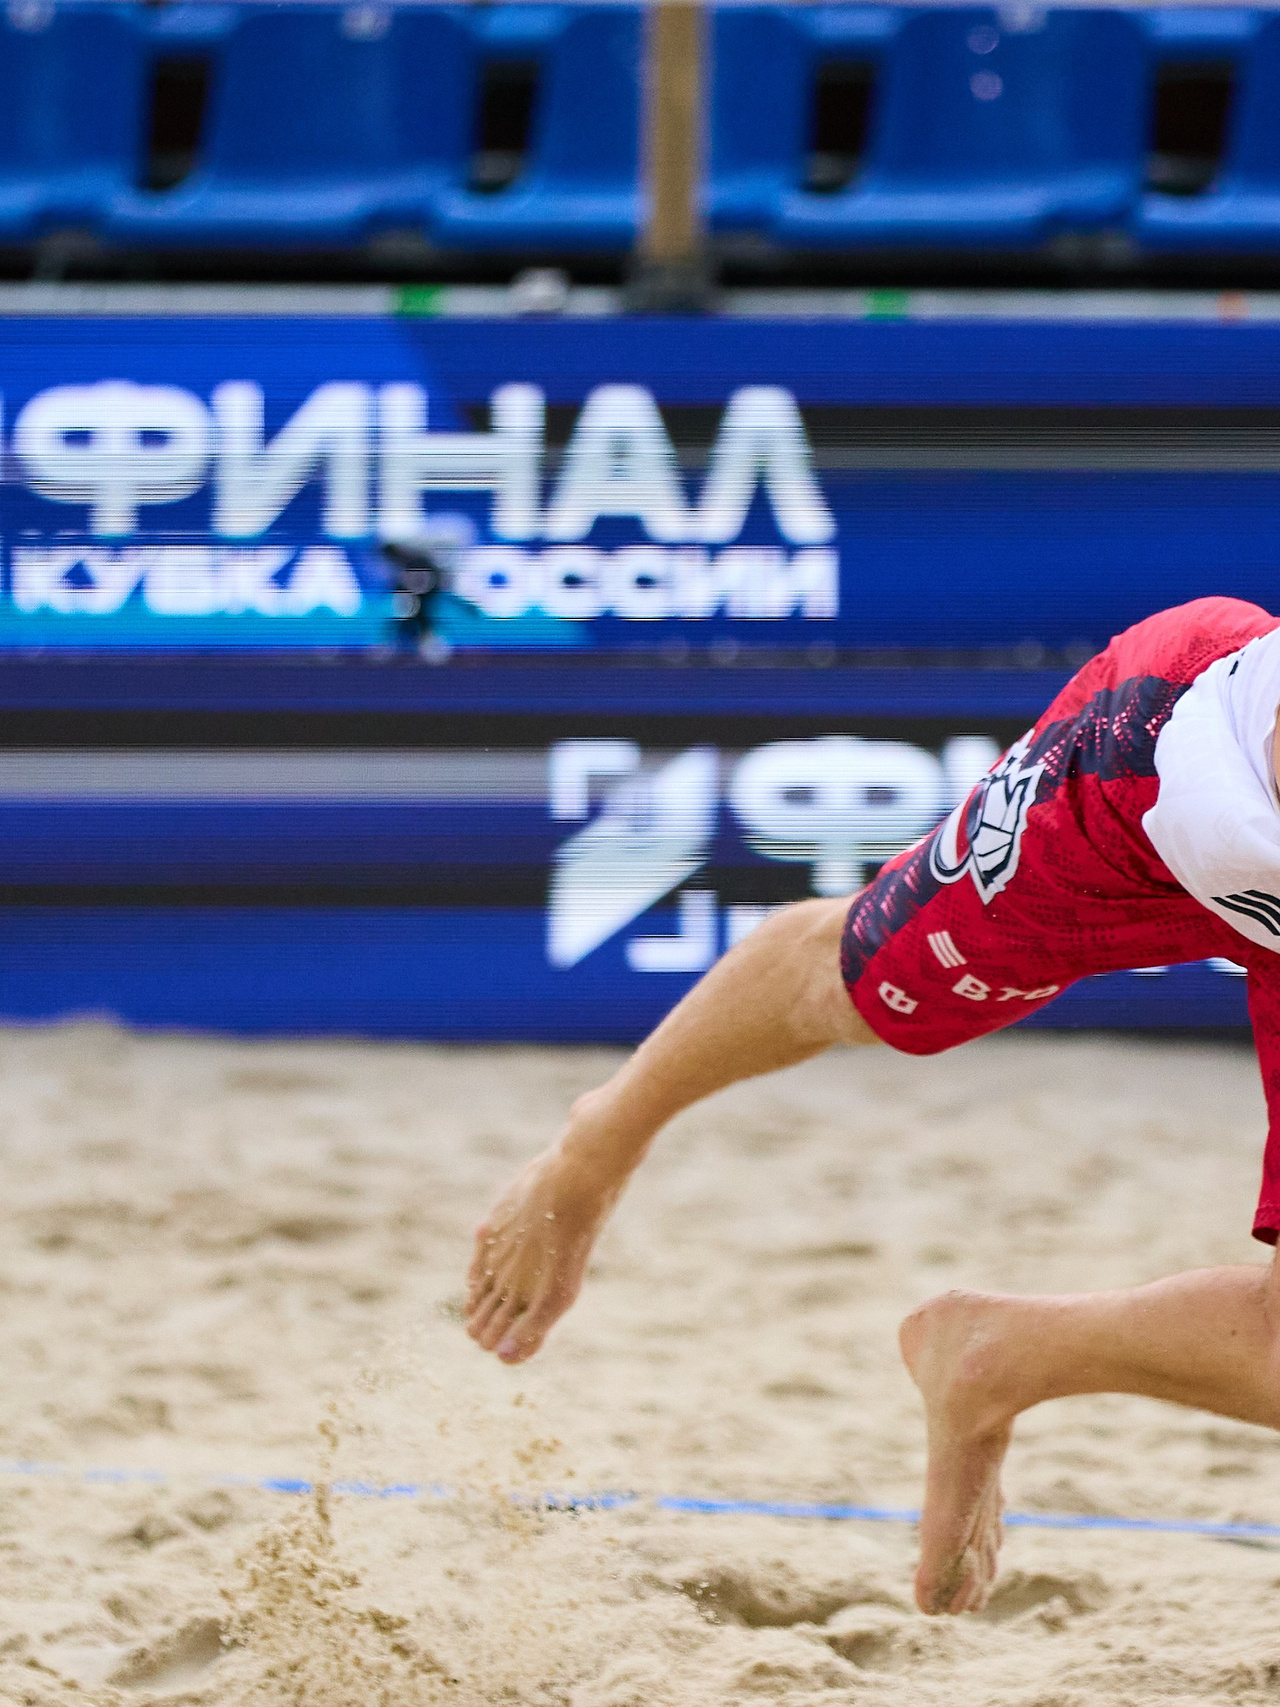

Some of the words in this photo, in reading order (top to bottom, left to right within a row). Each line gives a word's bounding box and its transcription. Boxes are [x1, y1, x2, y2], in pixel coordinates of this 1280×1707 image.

[12, 379, 838, 544] ФИНАЛ
[10, 544, 363, 617] КУБКА
[448, 545, 839, 621] ОССИИ
